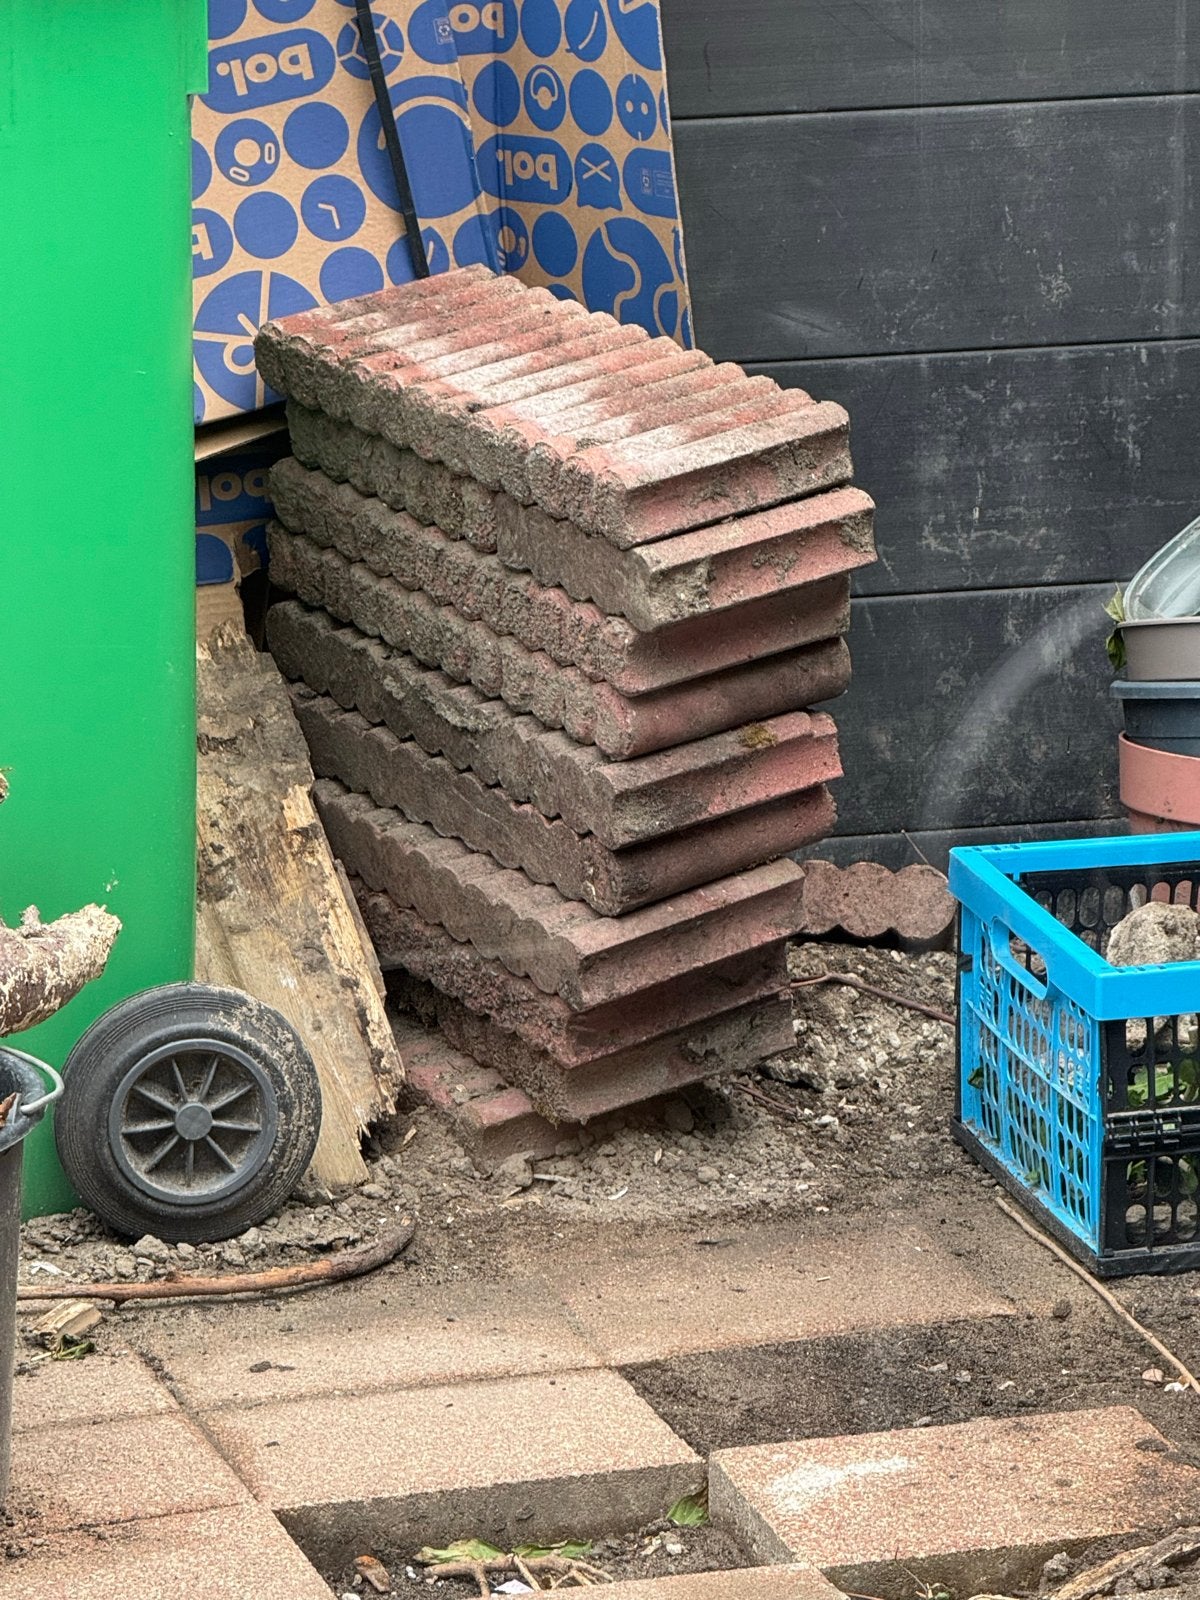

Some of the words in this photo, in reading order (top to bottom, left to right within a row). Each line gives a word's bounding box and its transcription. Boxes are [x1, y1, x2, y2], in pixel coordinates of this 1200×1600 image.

[448, 2, 505, 39] bo
[216, 42, 314, 96] bol.
[496, 149, 558, 190] bol.
